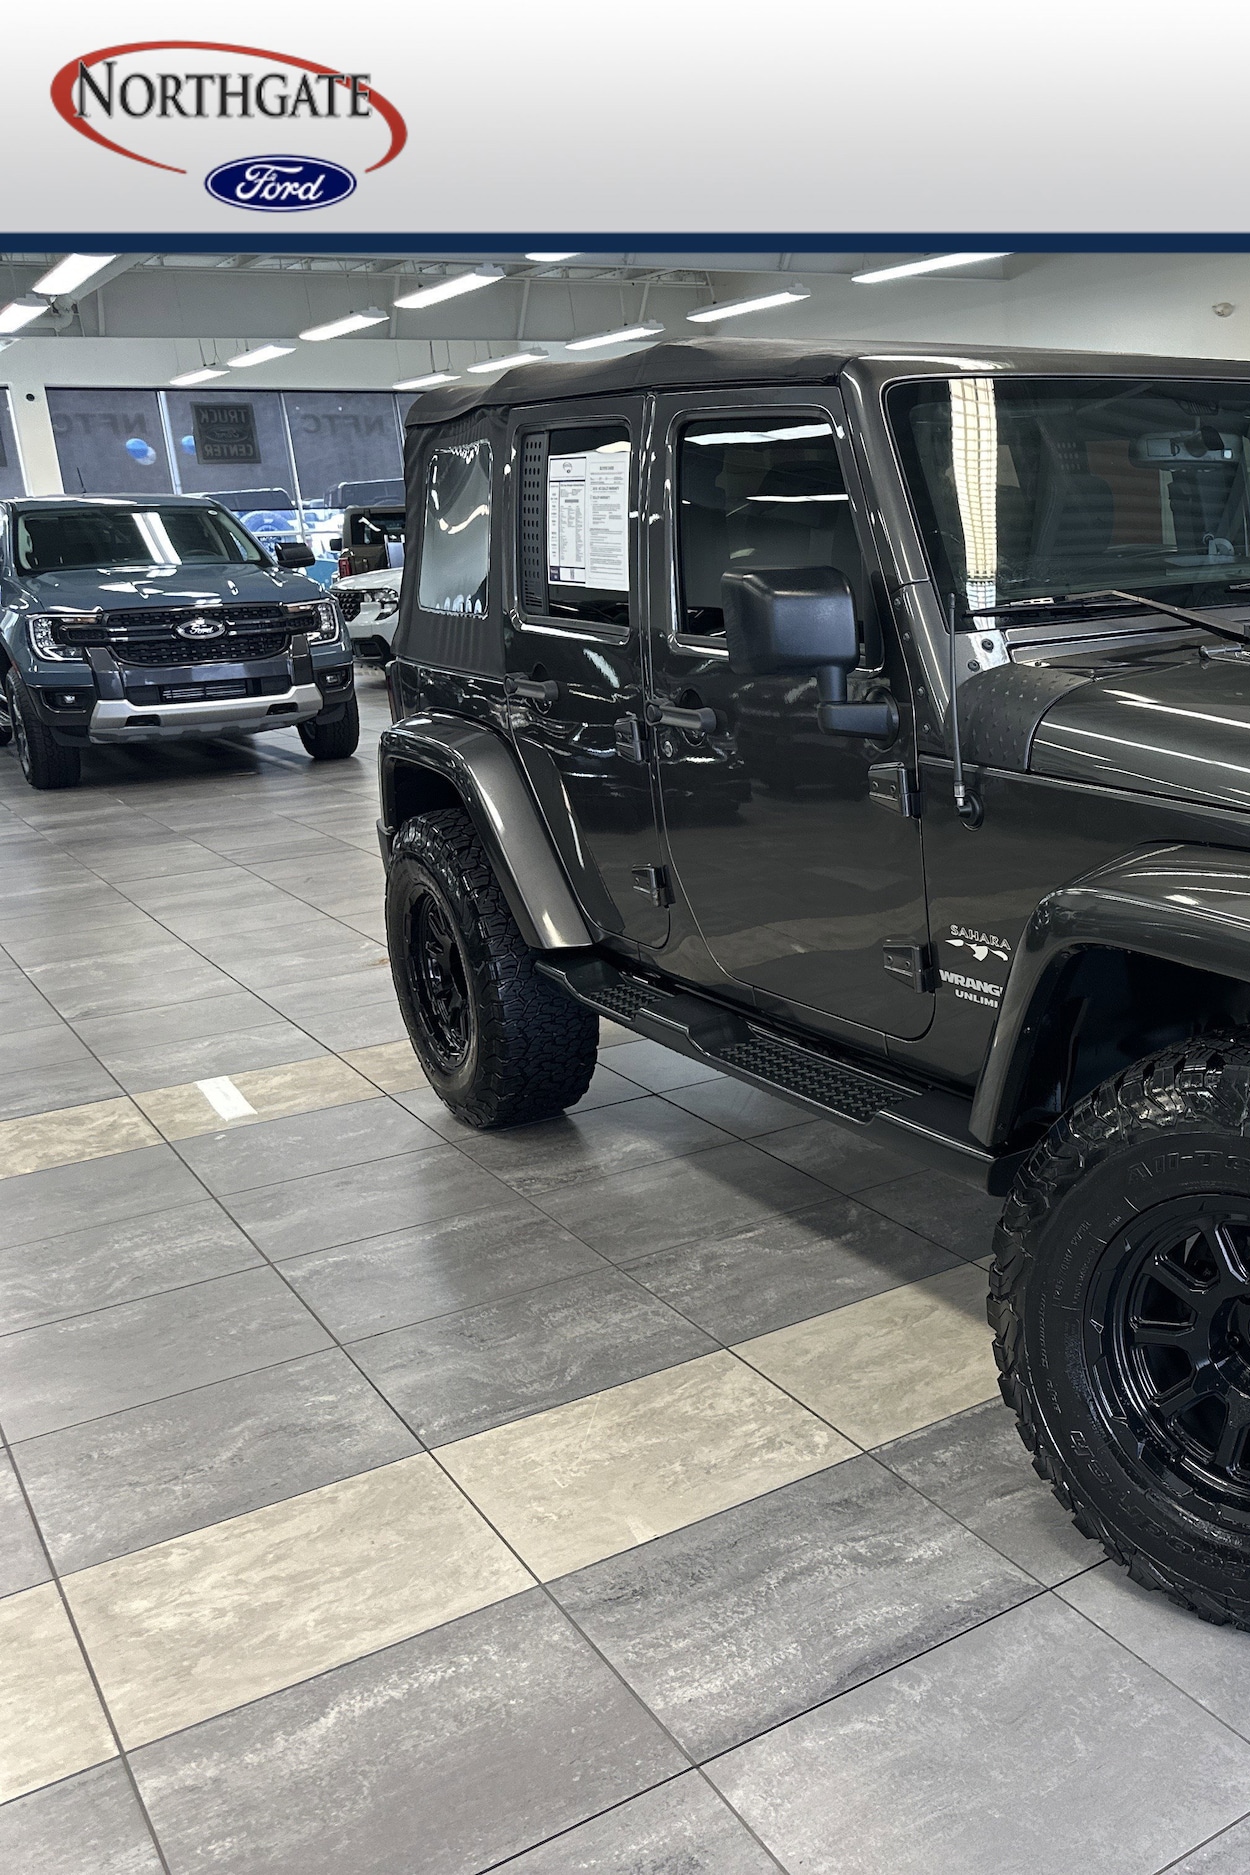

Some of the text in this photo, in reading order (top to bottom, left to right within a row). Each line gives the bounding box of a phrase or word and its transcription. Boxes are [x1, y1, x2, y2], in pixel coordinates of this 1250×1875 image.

[950, 924, 1012, 951] SAHARA
[939, 969, 1003, 997] WRANG
[955, 989, 999, 1008] UNLIMI
